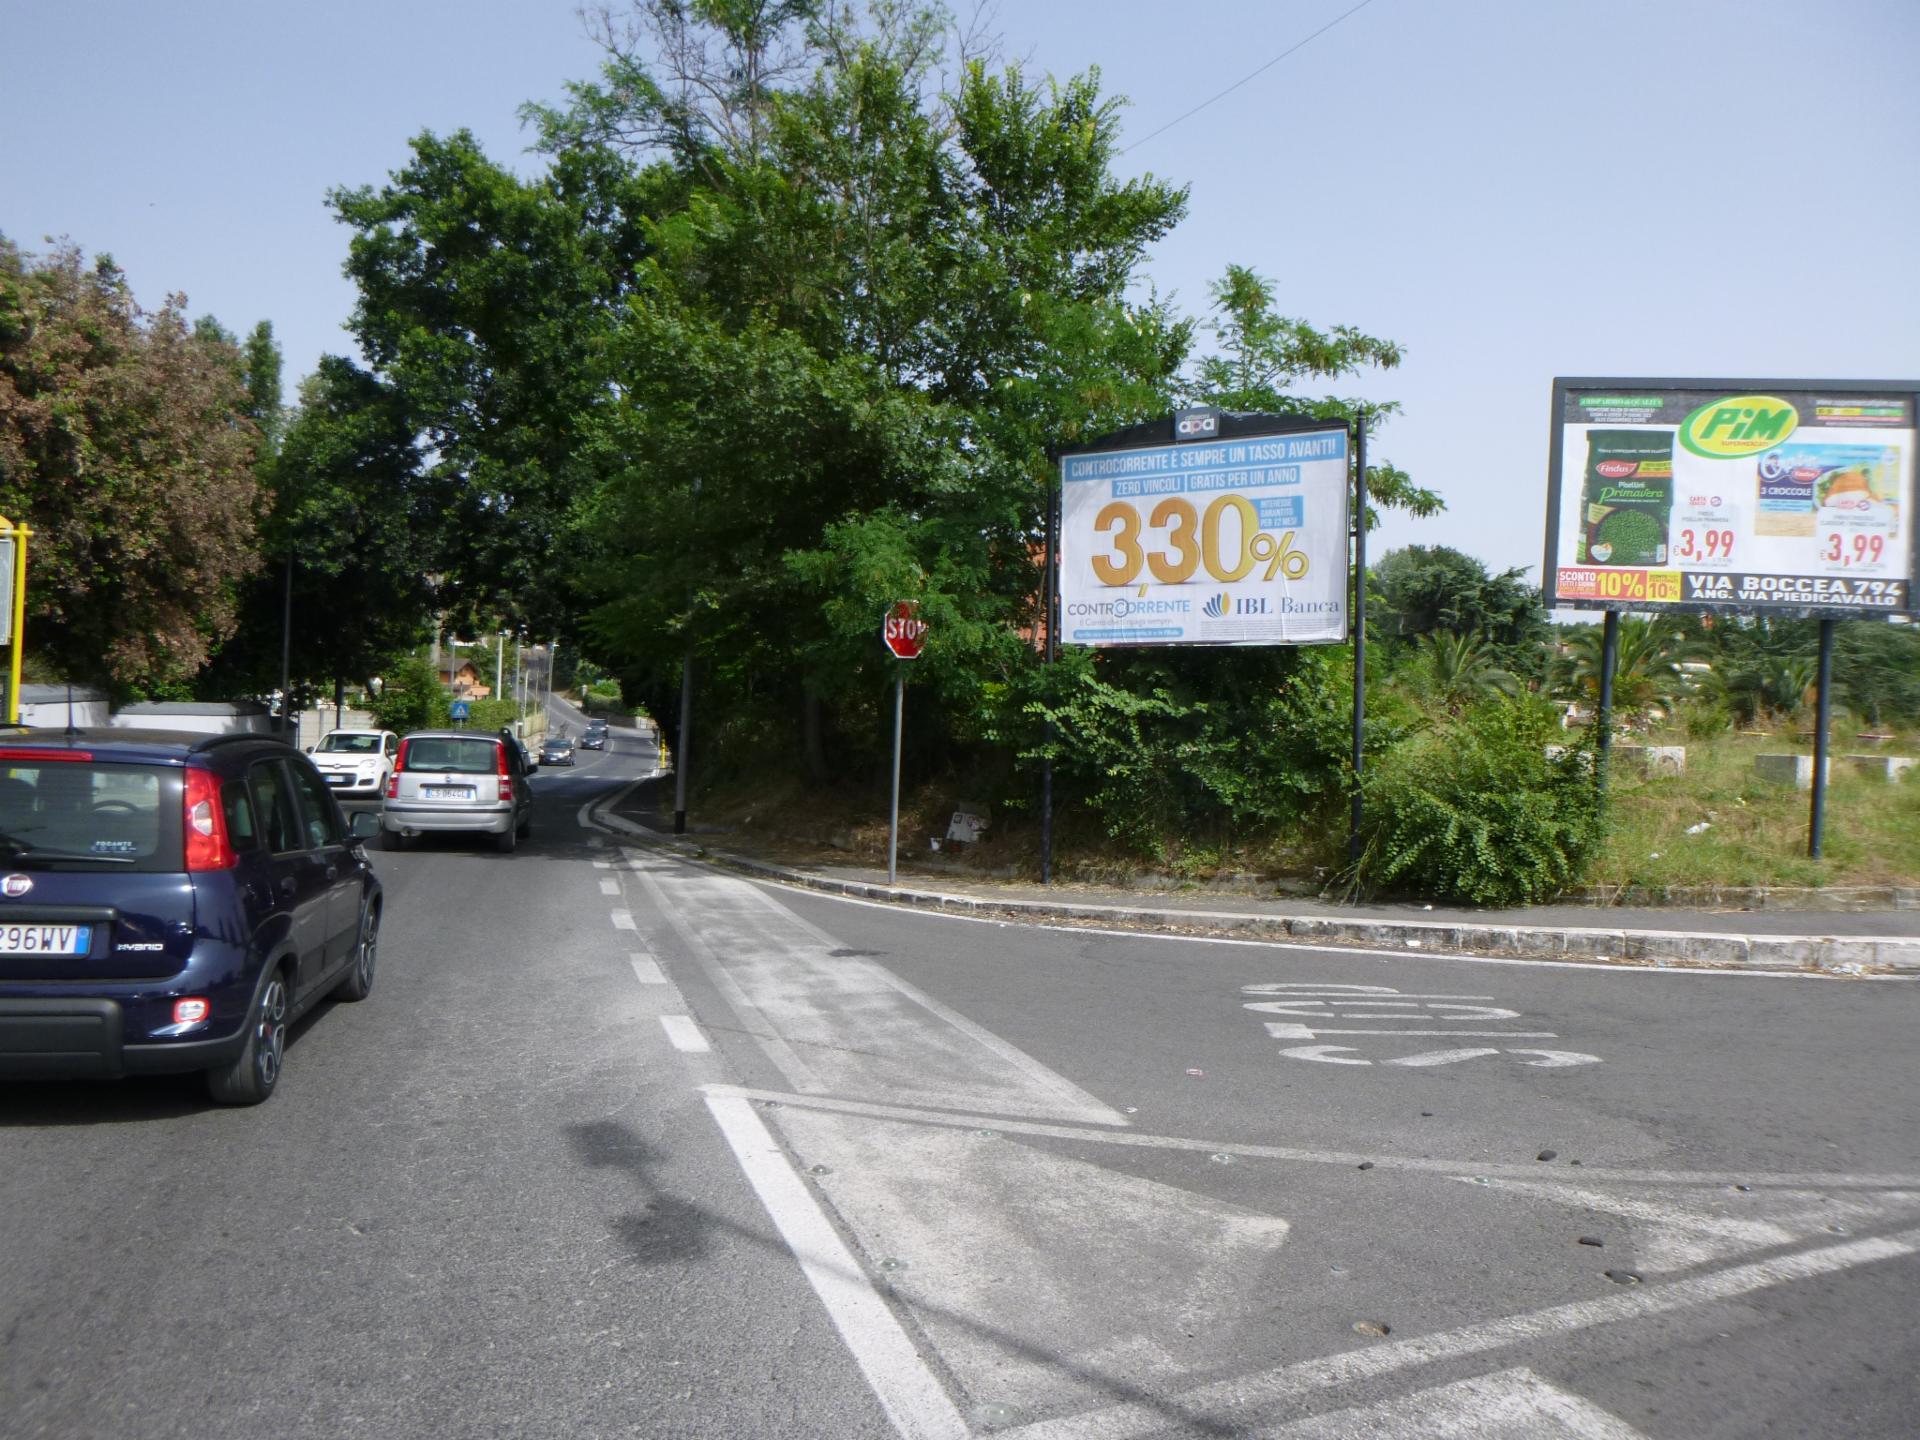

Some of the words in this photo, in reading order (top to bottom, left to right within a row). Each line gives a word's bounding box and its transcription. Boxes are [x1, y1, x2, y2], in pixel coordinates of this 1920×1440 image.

[1071, 453, 1168, 477] CONTROCORRENTE
[1170, 450, 1178, 468] È
[1180, 447, 1226, 467] SEMPRE
[1228, 446, 1246, 463] UN
[1248, 443, 1286, 462] TASSO
[1600, 464, 1629, 473] Findus
[1116, 480, 1140, 496] ZERO
[1142, 475, 1180, 493] VINCOLI
[1190, 472, 1226, 489] GRATIS
[1228, 470, 1248, 487] PER
[1250, 469, 1265, 485] UN
[1267, 467, 1297, 483] ANNO
[1599, 486, 1664, 504] Primavera
[1769, 487, 1812, 497] CROCCOLE
[1091, 493, 1310, 598] 3,30%
[1680, 529, 1734, 562] 3,99
[1827, 533, 1884, 567] 3,99
[1559, 571, 1596, 581] SCONTO
[1597, 572, 1645, 598] 10%
[1688, 575, 1732, 590] VIA
[1743, 576, 1848, 595] BOCCEA
[1236, 598, 1273, 615] IBL
[1280, 597, 1339, 614] Banca
[1692, 589, 1734, 600] ANG.
[1738, 590, 1768, 601] VIA
[1772, 591, 1897, 607] PIEDICAVALLO
[117, 943, 164, 951] HYBRID
